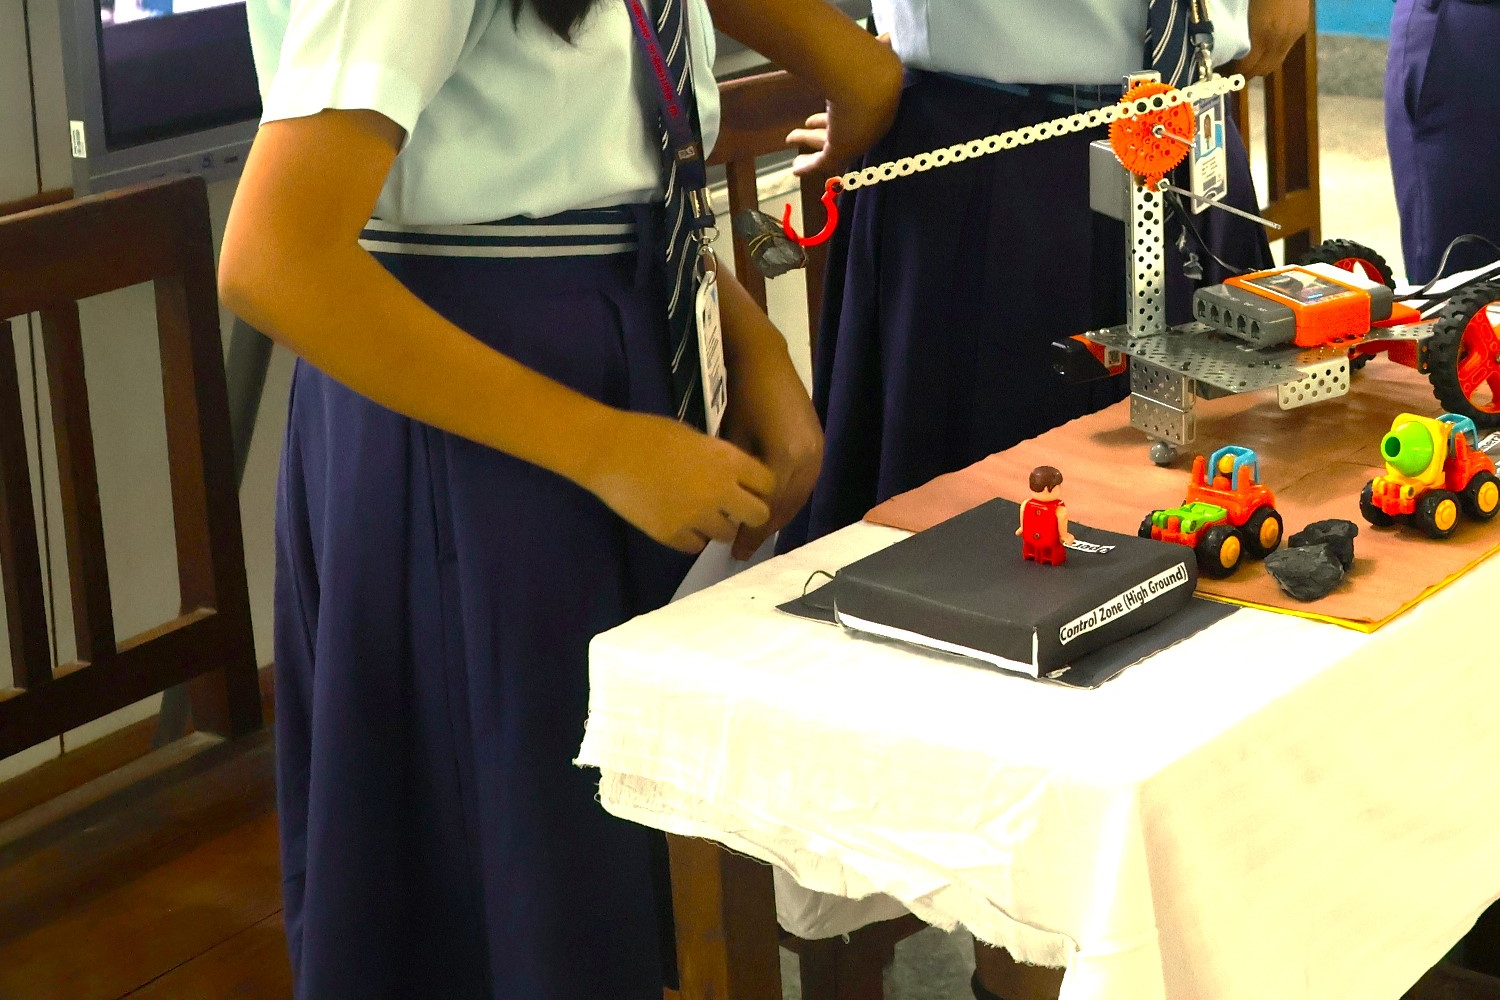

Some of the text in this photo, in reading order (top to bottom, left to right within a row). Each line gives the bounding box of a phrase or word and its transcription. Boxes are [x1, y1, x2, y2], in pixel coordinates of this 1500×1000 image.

[1060, 565, 1187, 641] Control Zone (High Ground)
